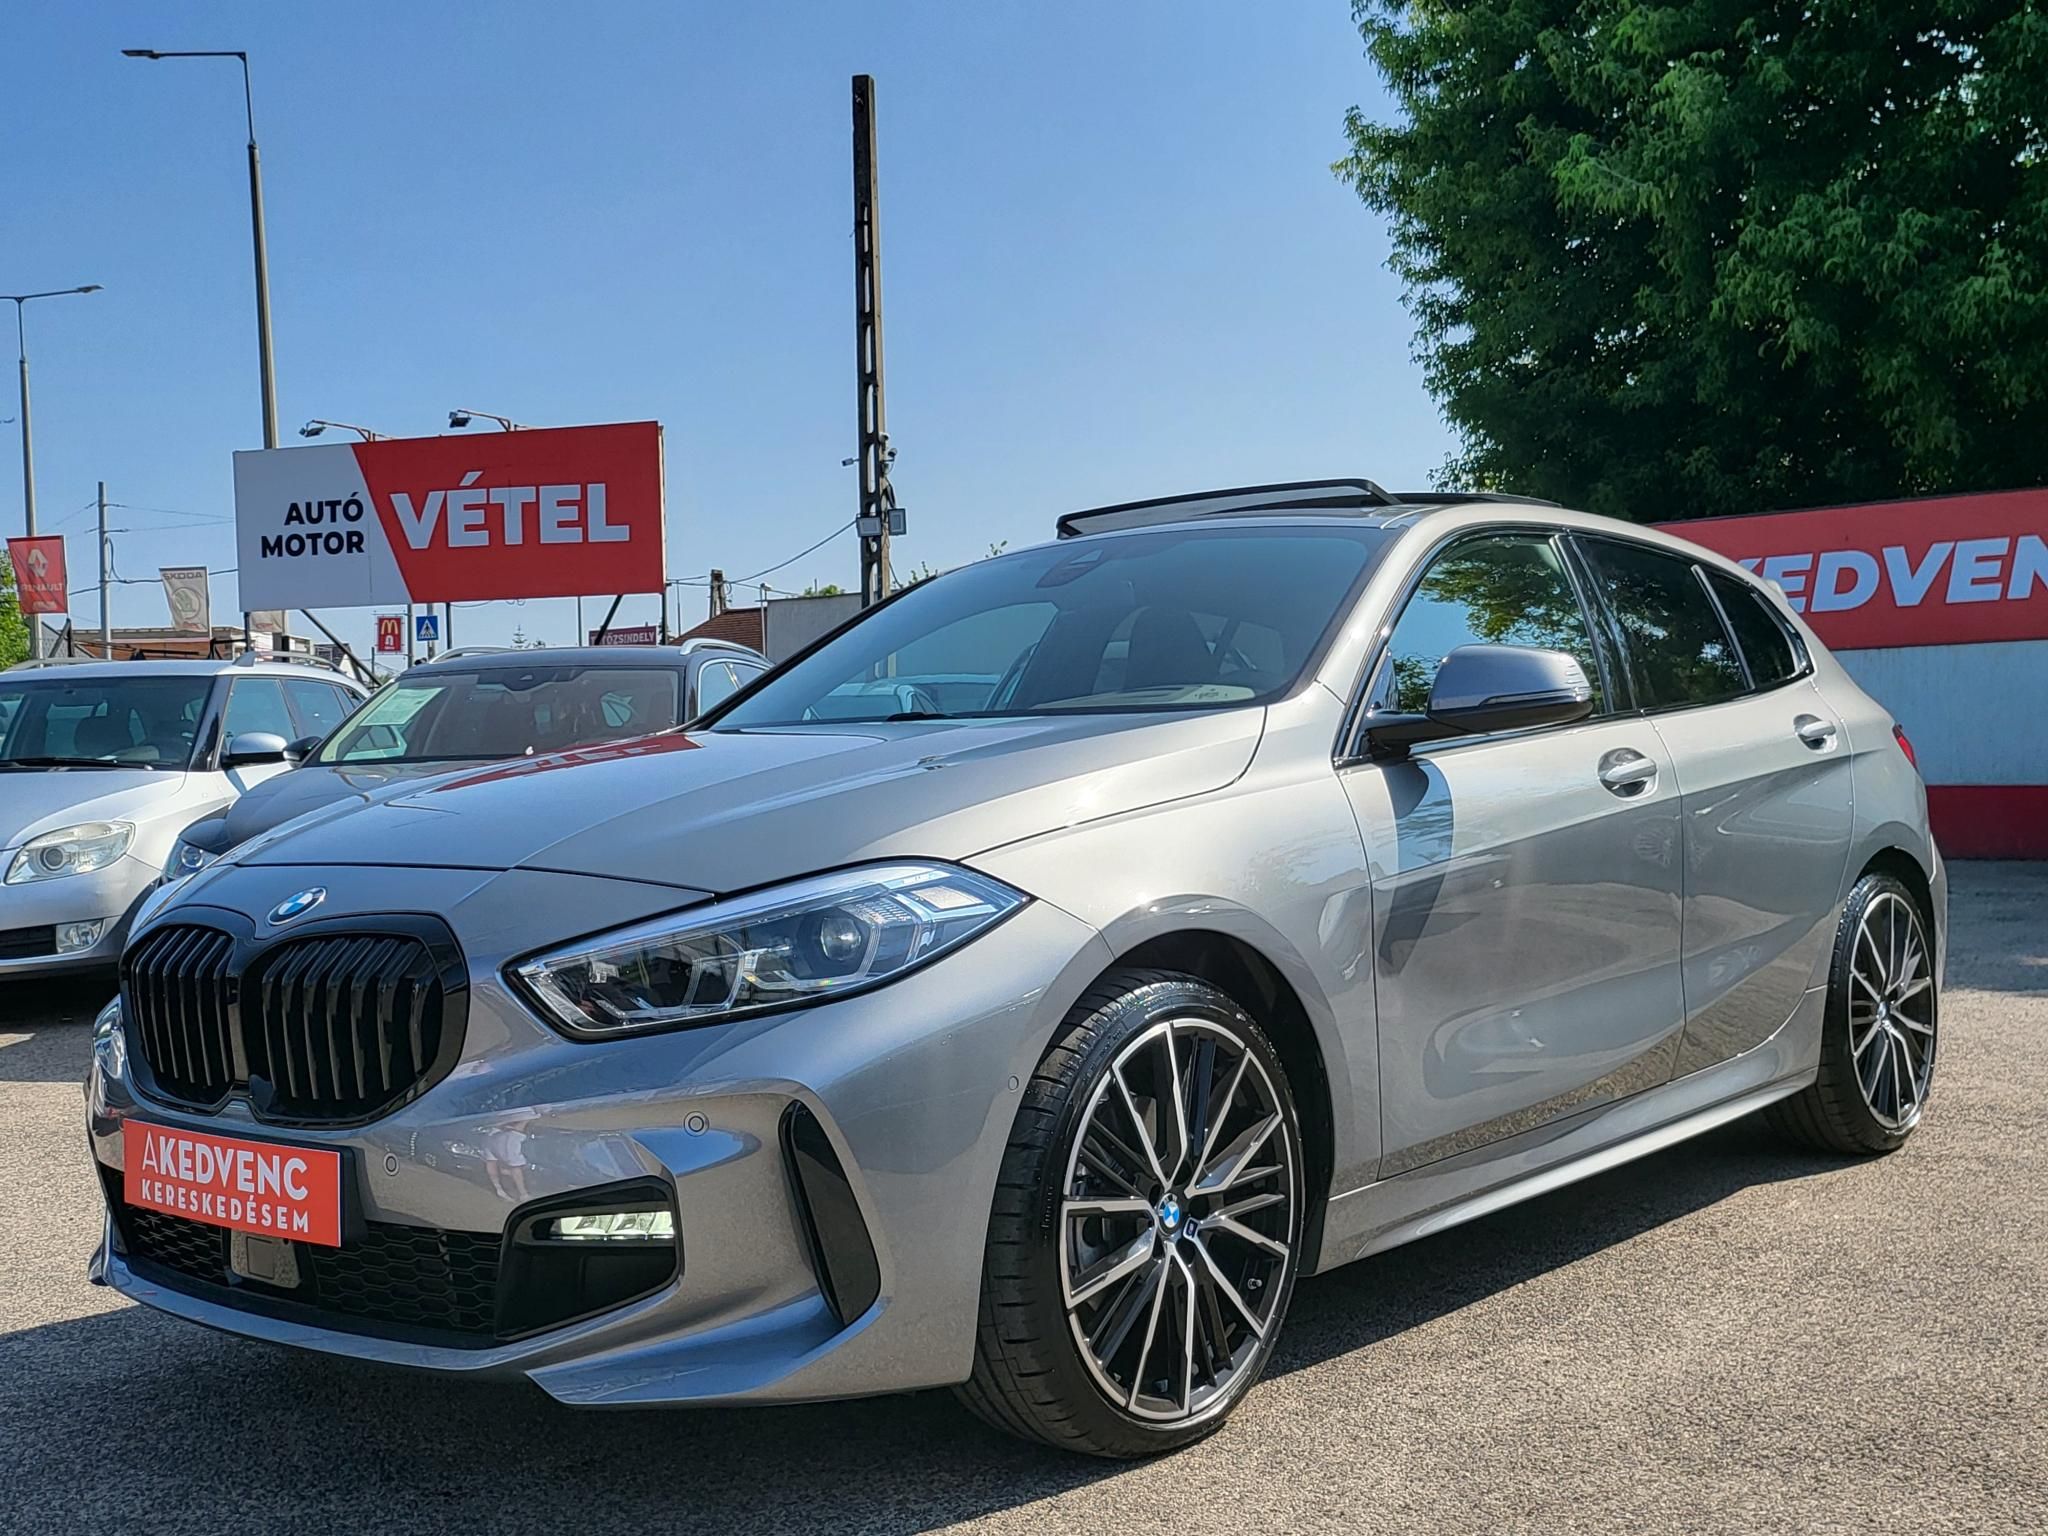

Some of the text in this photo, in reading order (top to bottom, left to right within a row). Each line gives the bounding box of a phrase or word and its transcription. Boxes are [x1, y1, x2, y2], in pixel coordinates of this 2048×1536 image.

[284, 492, 364, 526] AUTÓ
[390, 471, 631, 550] VÉTEL
[261, 530, 364, 558] MOTOR
[1738, 534, 2048, 614] EDVEN
[142, 1178, 309, 1233] KERESKEDÉSEM
